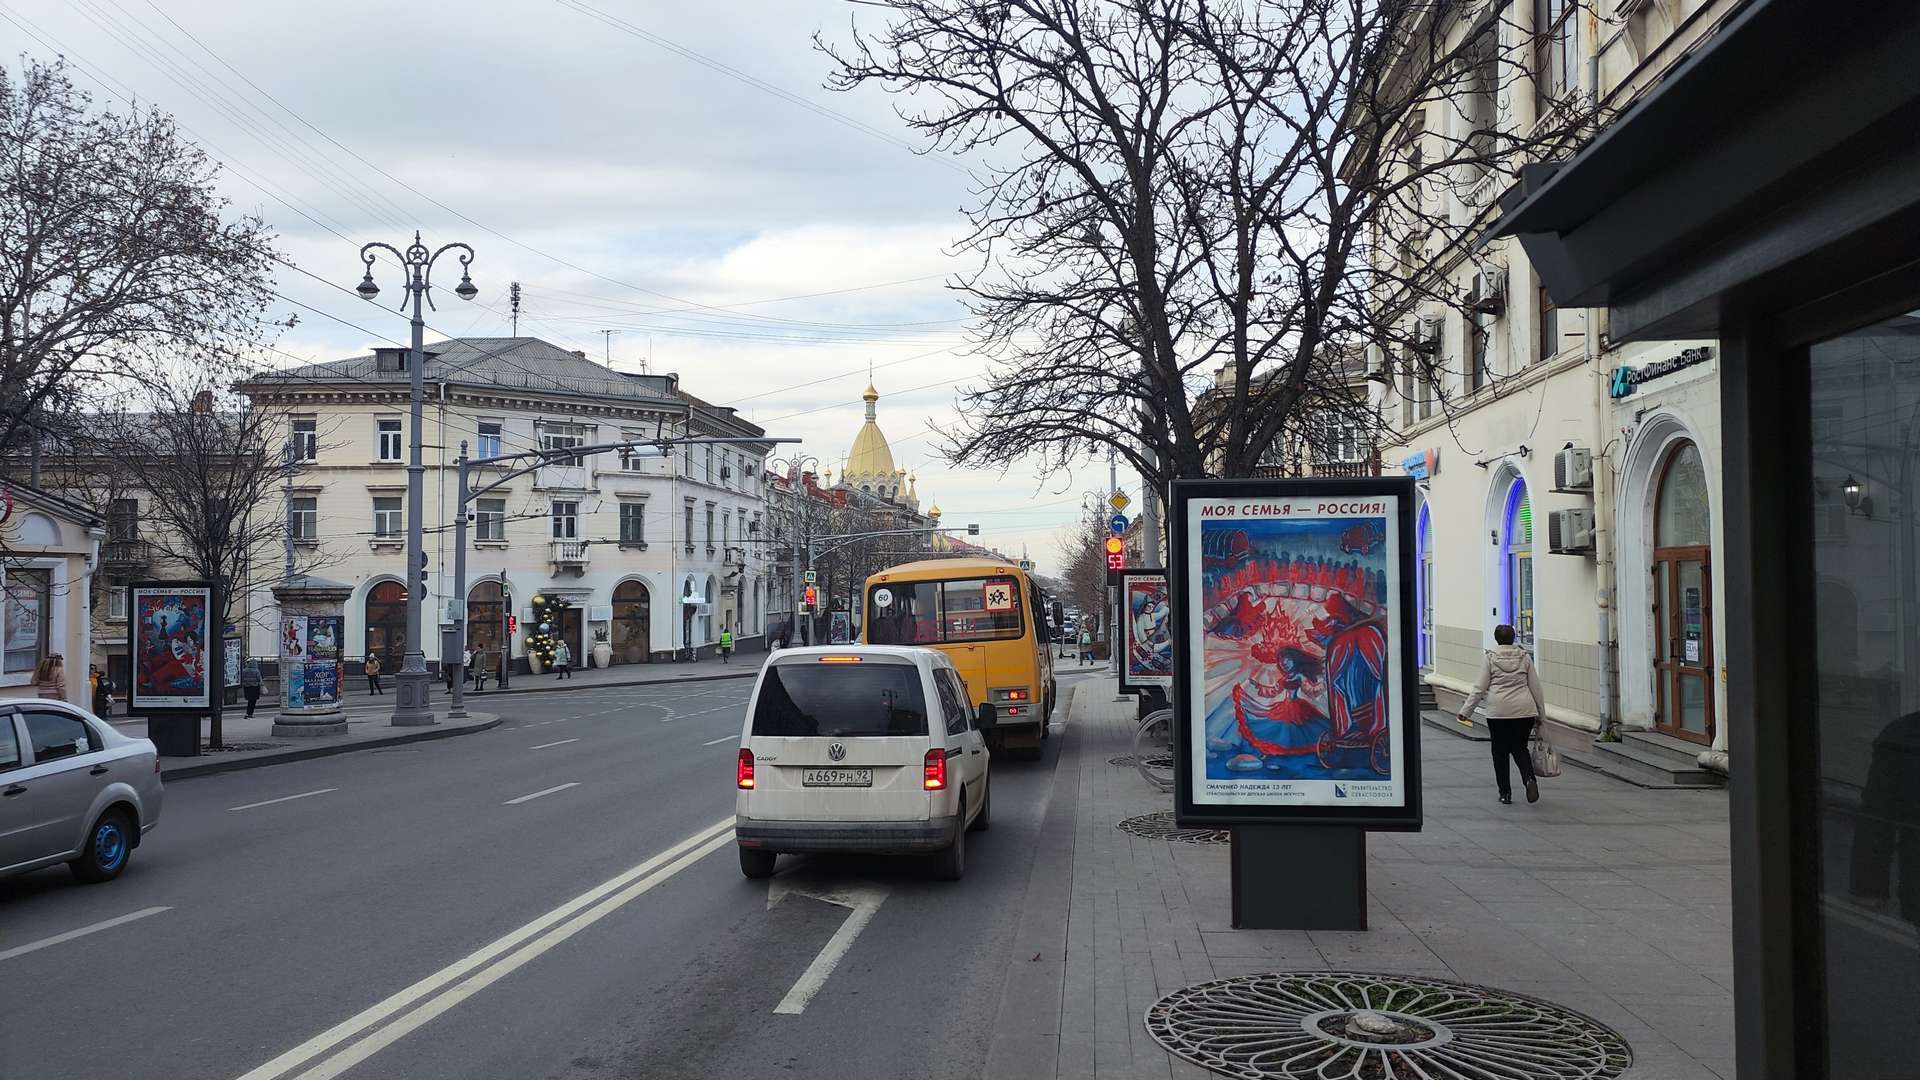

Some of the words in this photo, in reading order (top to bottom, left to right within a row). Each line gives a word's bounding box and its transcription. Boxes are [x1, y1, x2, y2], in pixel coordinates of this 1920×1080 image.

[1626, 356, 1678, 384] РостФинанс
[1681, 348, 1702, 365] Банк
[1201, 505, 1235, 516] МОЯ
[1242, 504, 1291, 516] СЕМЬЯ
[1317, 503, 1386, 515] РОССИЯ!
[1108, 554, 1123, 569] 53
[878, 593, 889, 602] 60
